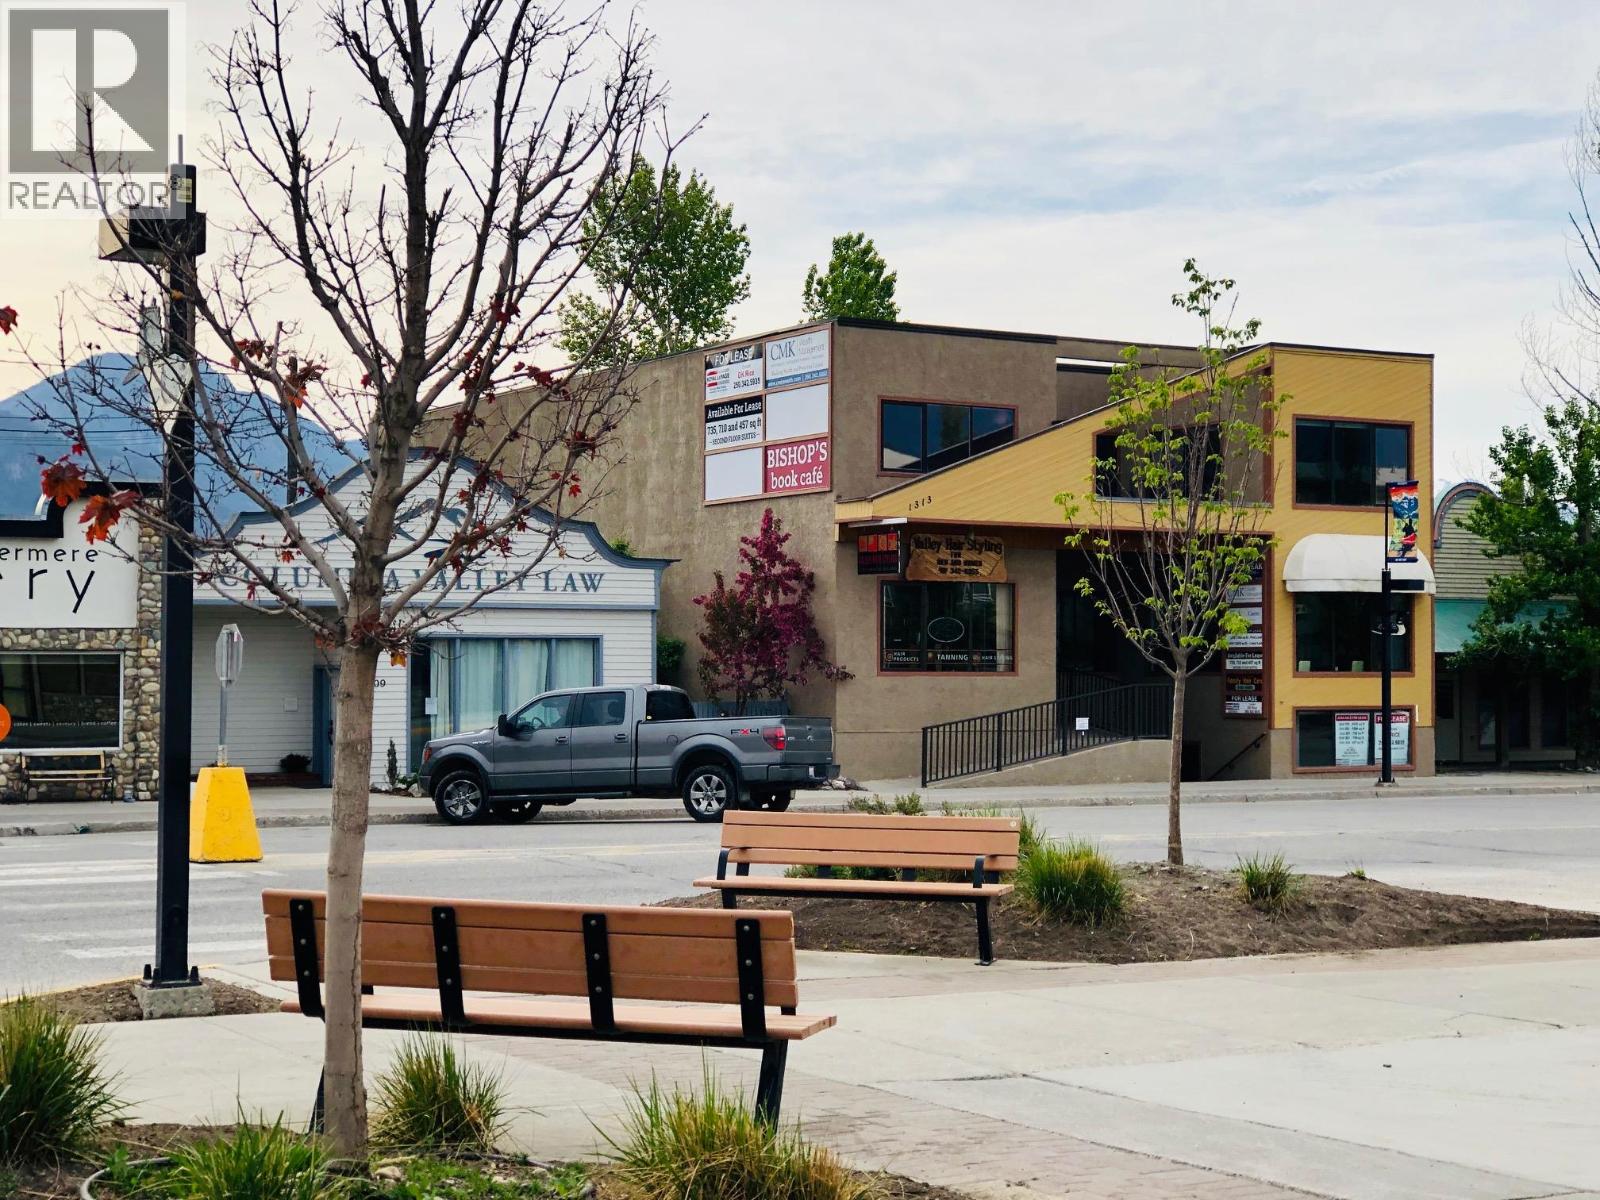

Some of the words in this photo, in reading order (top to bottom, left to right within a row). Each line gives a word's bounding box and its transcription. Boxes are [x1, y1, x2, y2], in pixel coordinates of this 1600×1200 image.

[770, 340, 796, 361] CMK
[707, 406, 733, 419] Available
[734, 404, 744, 414] For
[744, 401, 762, 412] Lease
[719, 423, 727, 433] 710
[728, 421, 738, 431] and
[767, 441, 828, 469] BISHOP'S
[771, 469, 799, 489] book
[800, 465, 823, 486] café
[908, 495, 932, 511] 1313
[914, 536, 942, 553] Valley
[944, 537, 964, 551] Hair
[967, 539, 1003, 556] Styling
[543, 570, 605, 593] LAW
[937, 653, 969, 661] TANNING
